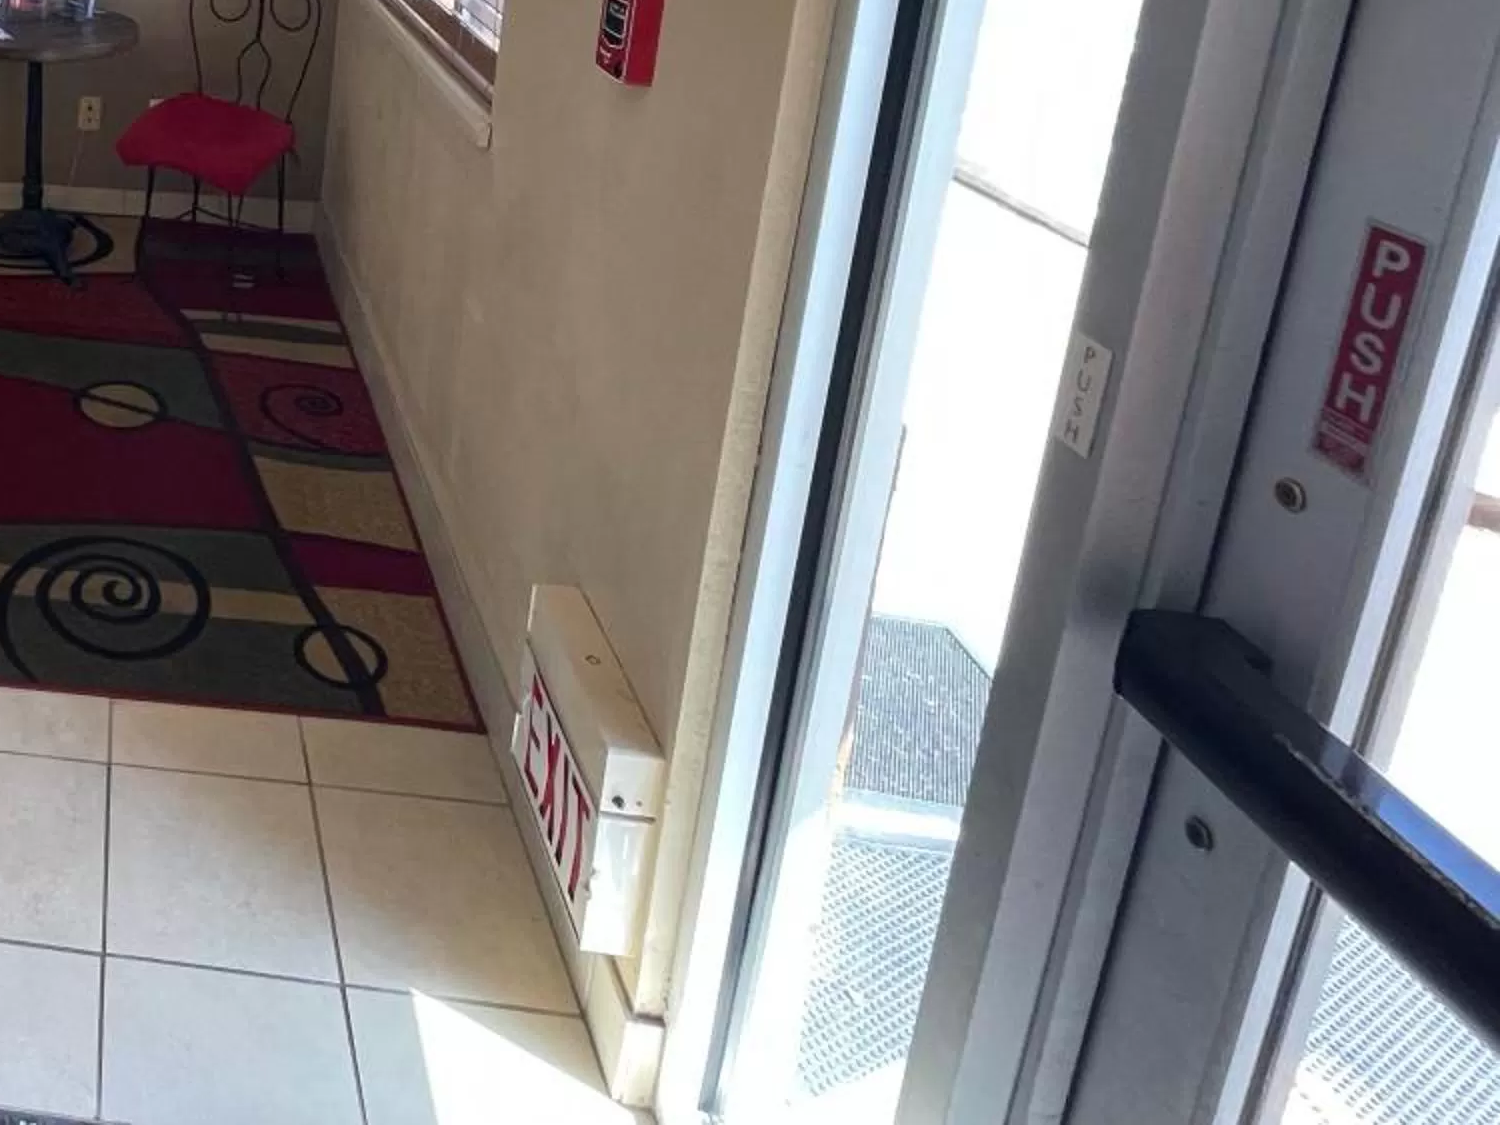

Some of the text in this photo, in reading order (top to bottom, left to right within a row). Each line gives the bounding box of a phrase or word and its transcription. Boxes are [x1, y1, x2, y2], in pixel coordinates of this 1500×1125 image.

[1064, 345, 1097, 443] PUSH
[1335, 240, 1410, 424] PUSH
[522, 672, 592, 903] EXIT
